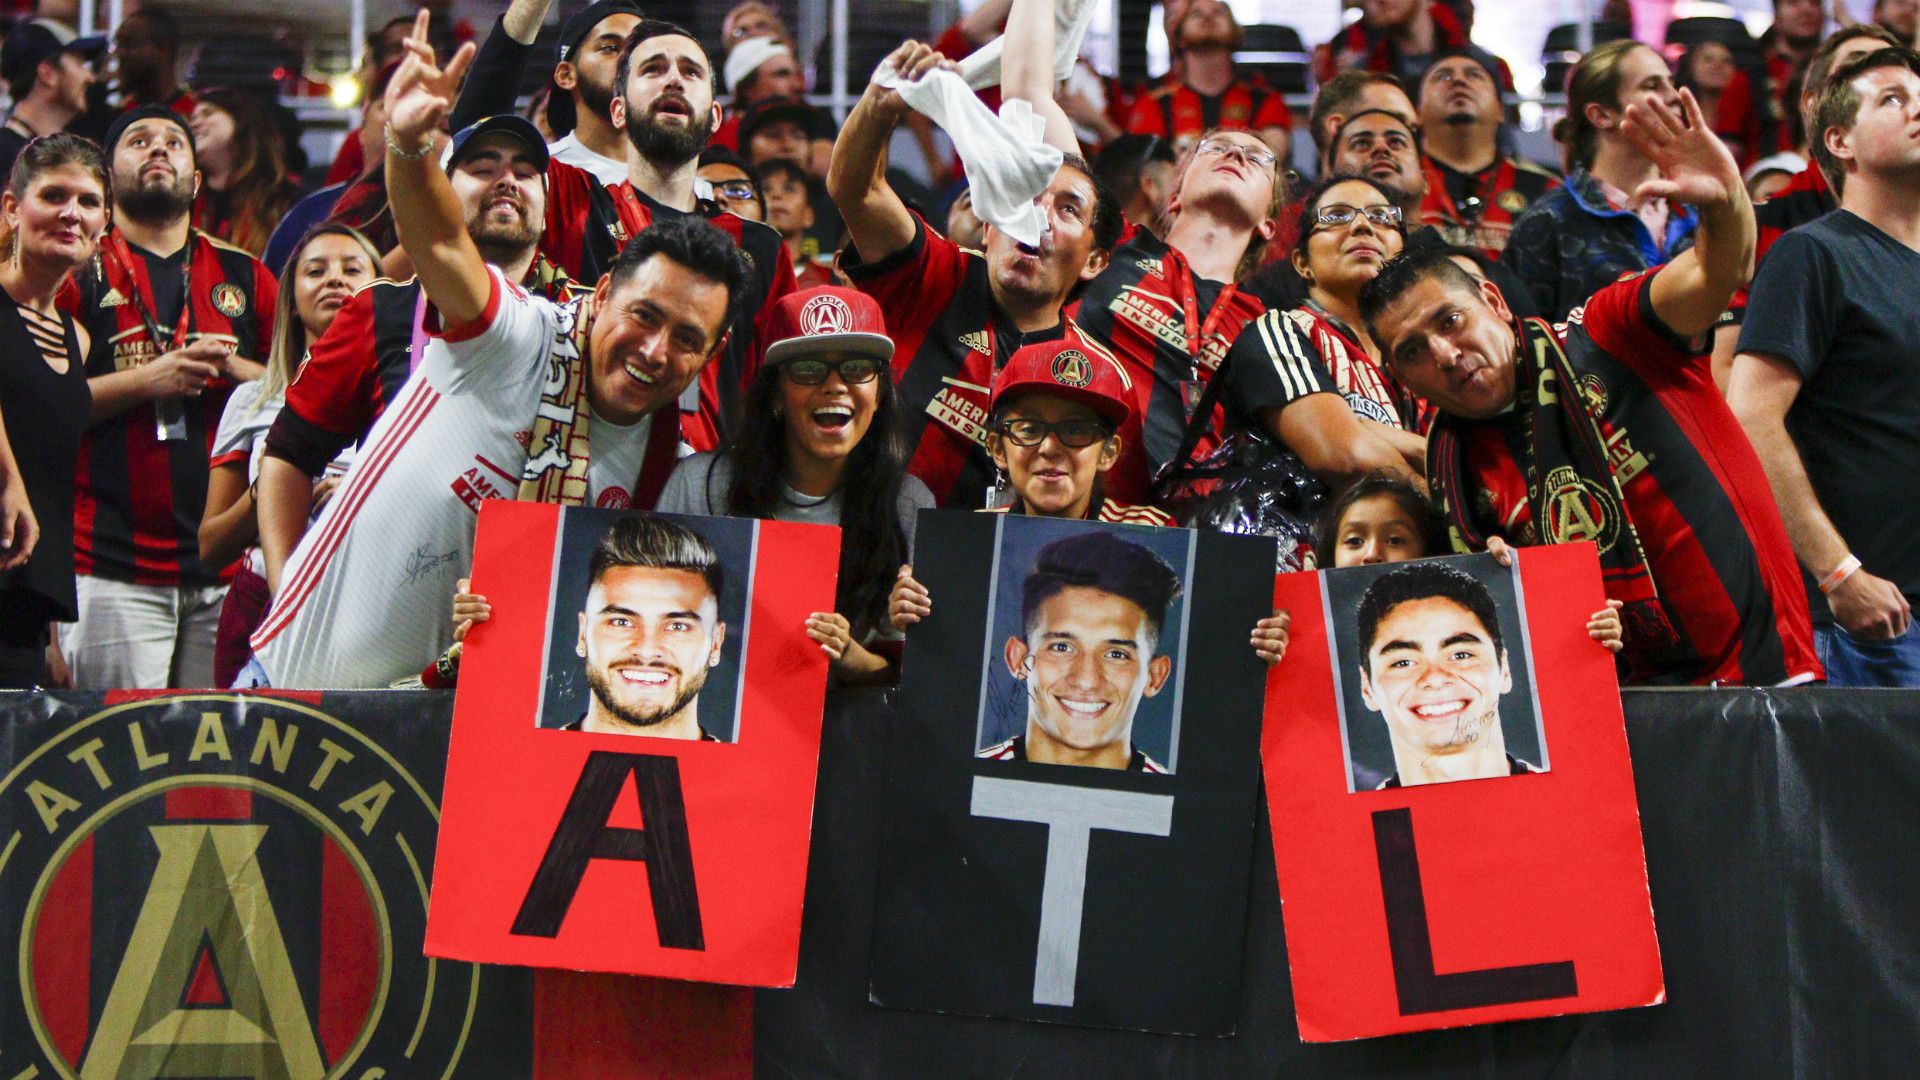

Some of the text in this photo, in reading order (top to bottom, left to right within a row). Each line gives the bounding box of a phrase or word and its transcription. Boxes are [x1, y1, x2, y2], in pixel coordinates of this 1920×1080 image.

[958, 335, 992, 357] adidas
[1116, 290, 1187, 339] AMERICA
[934, 386, 989, 427] AMERI
[25, 711, 397, 837] ATLANTA
[509, 750, 706, 951] A
[971, 775, 1174, 1007] T
[1371, 807, 1579, 1016] L
